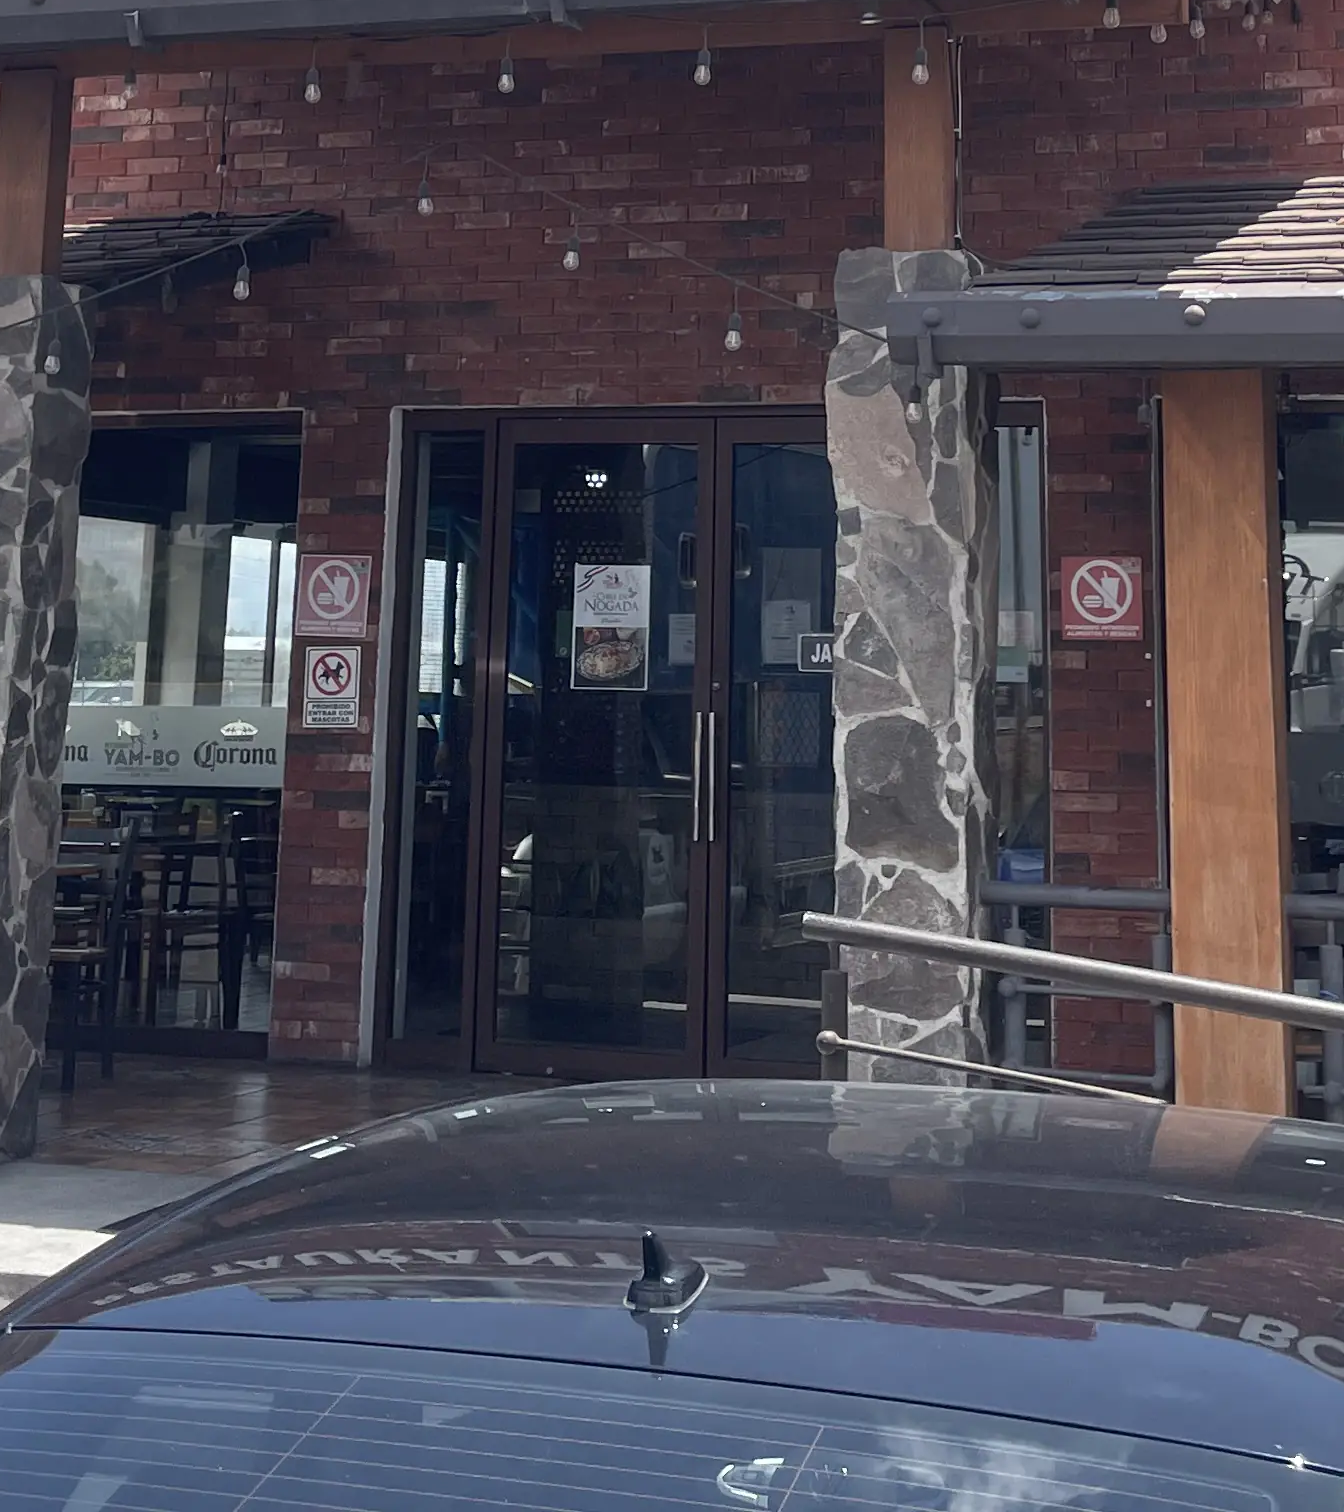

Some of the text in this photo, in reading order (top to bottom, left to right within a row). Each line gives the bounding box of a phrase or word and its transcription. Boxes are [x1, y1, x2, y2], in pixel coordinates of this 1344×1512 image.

[584, 598, 639, 612] NOGADA
[810, 643, 833, 663] JA
[105, 748, 180, 768] YAM-BO
[193, 739, 278, 773] Corona
